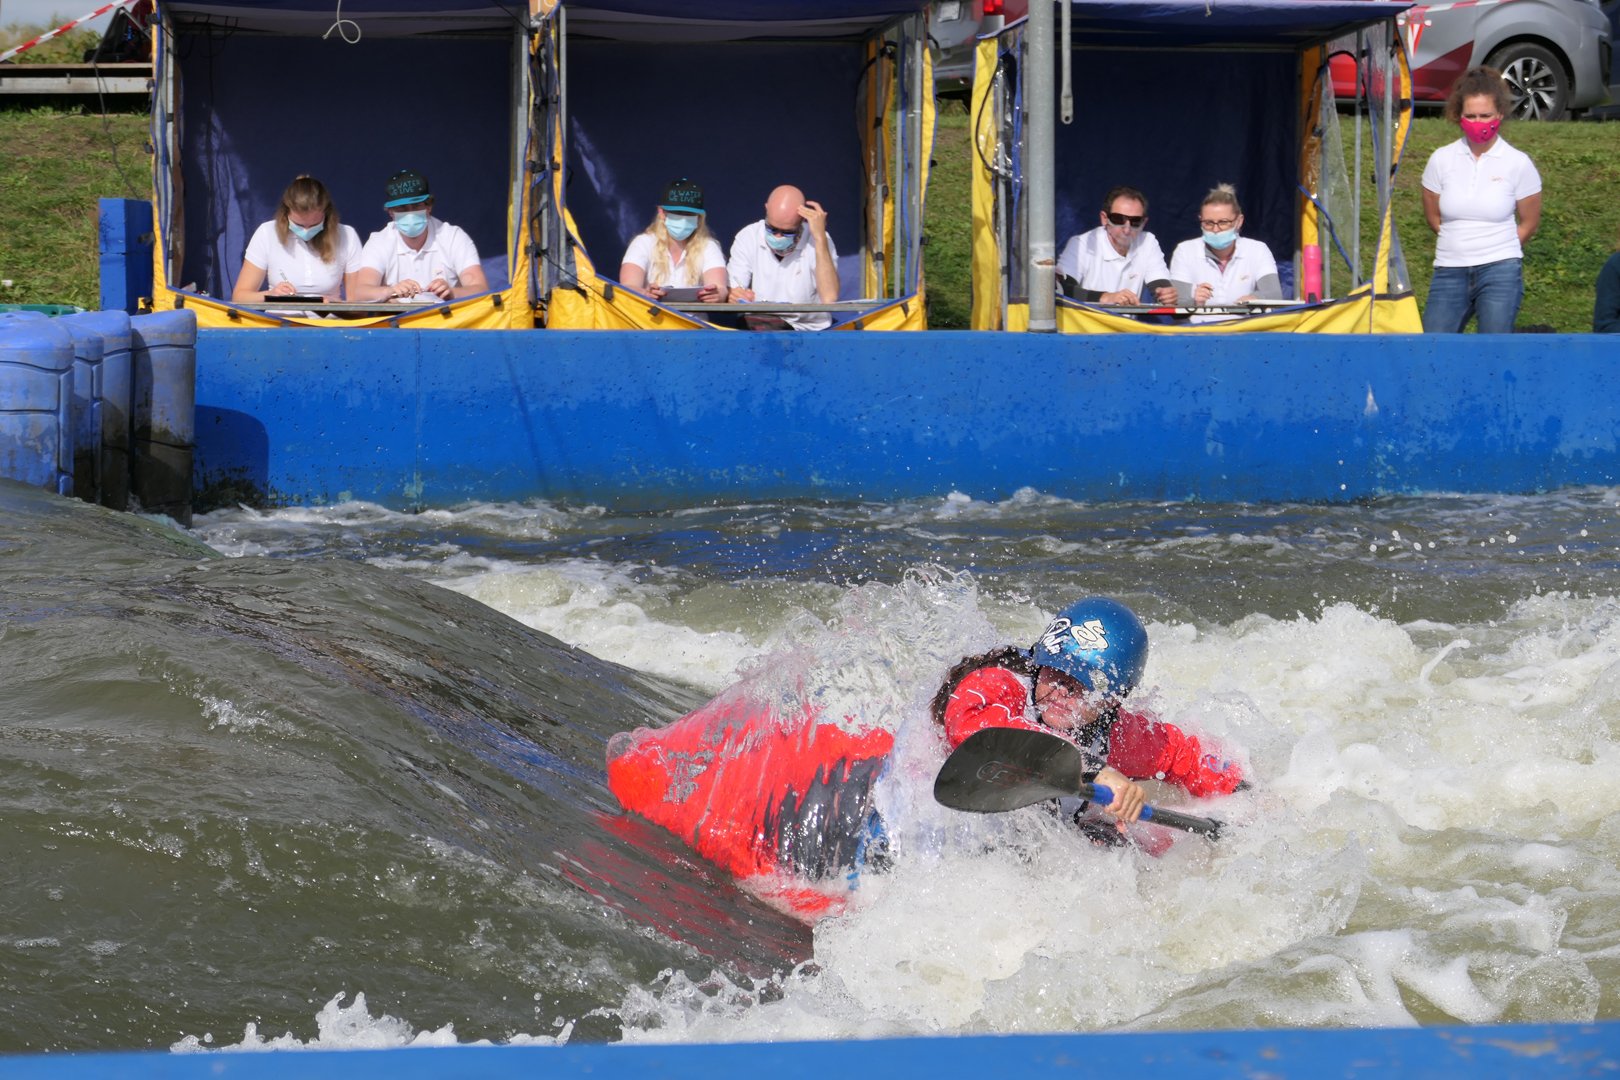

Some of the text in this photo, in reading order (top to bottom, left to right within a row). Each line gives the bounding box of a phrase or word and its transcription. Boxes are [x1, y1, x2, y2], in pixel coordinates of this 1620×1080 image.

[396, 179, 421, 189] WATER
[399, 187, 415, 195] LIVE
[678, 190, 702, 198] WATER
[680, 196, 695, 204] LIVE
